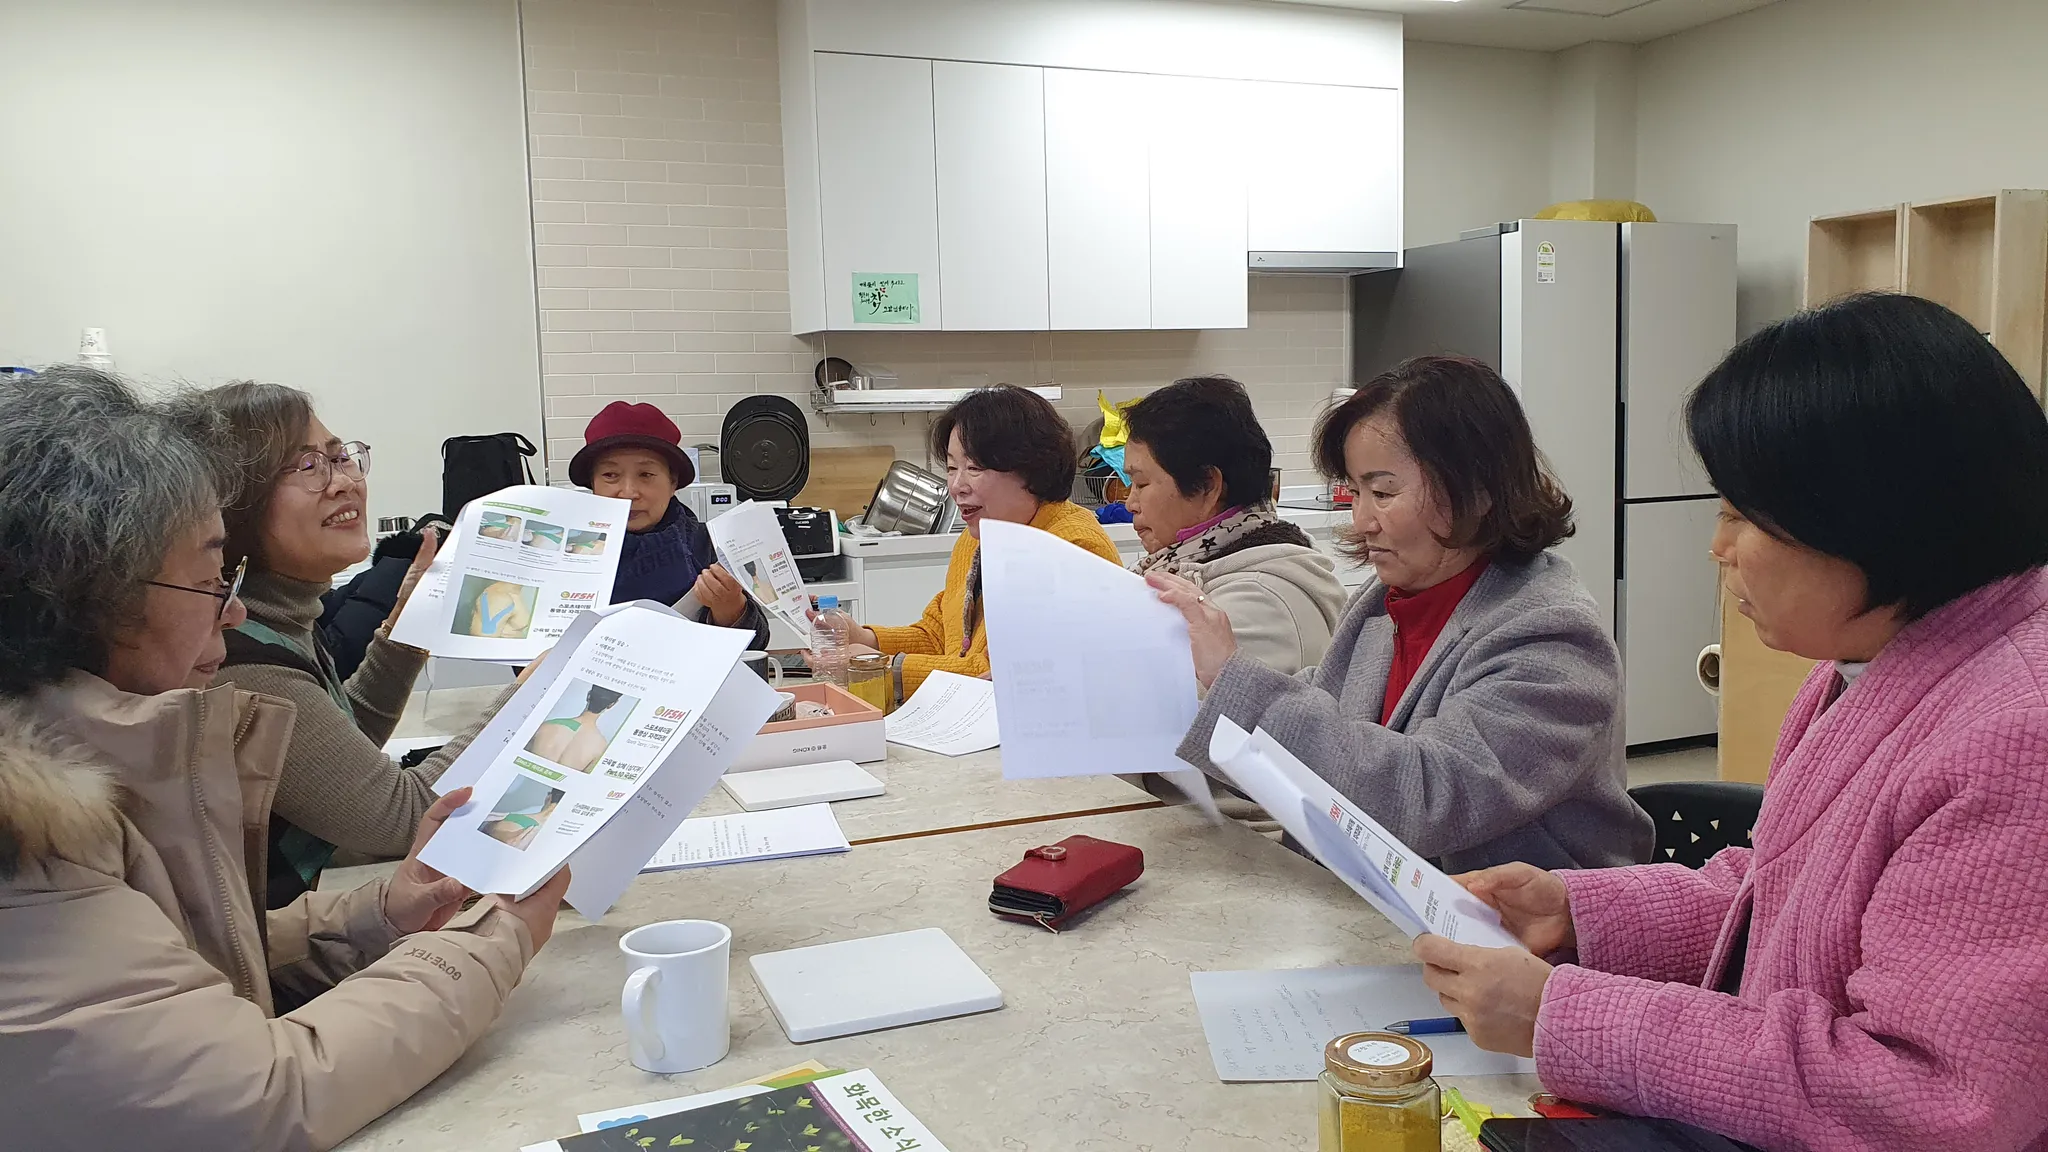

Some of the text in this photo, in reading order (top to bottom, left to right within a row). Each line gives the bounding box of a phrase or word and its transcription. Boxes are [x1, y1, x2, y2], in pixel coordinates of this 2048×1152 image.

[570, 592, 595, 600] IFSH
[661, 708, 686, 720] IFSH
[404, 947, 462, 981] GORE-TEX
[843, 1082, 893, 1123] 화목한
